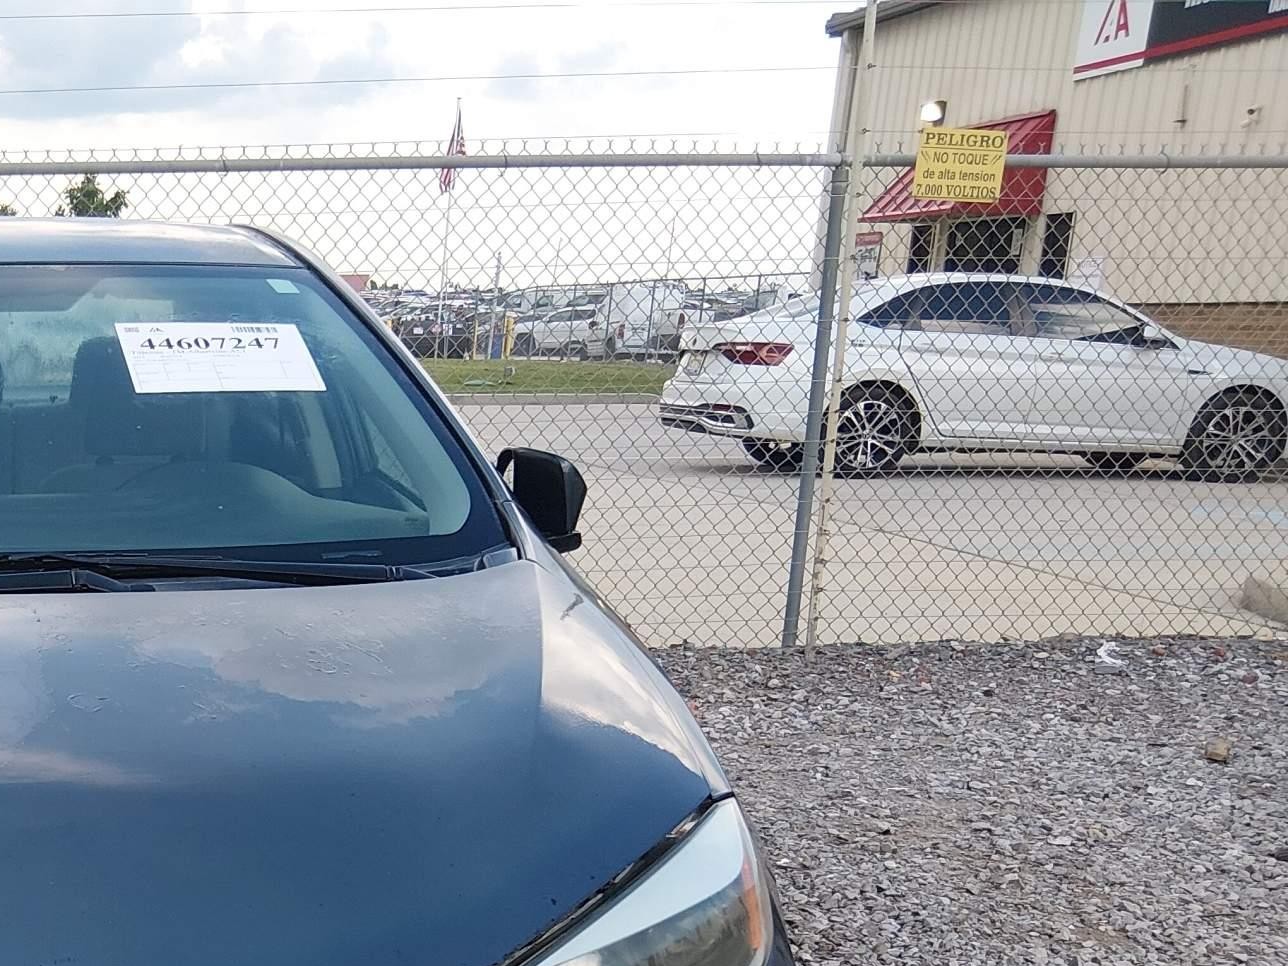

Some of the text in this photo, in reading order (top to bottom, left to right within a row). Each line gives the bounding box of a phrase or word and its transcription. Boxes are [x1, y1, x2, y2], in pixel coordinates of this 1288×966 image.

[924, 132, 1004, 149] PELIGRO
[932, 151, 989, 165] NO TOQUE
[922, 168, 996, 183] de alta tension
[946, 185, 997, 199] VOLTIOS
[140, 337, 280, 350] 44607247
